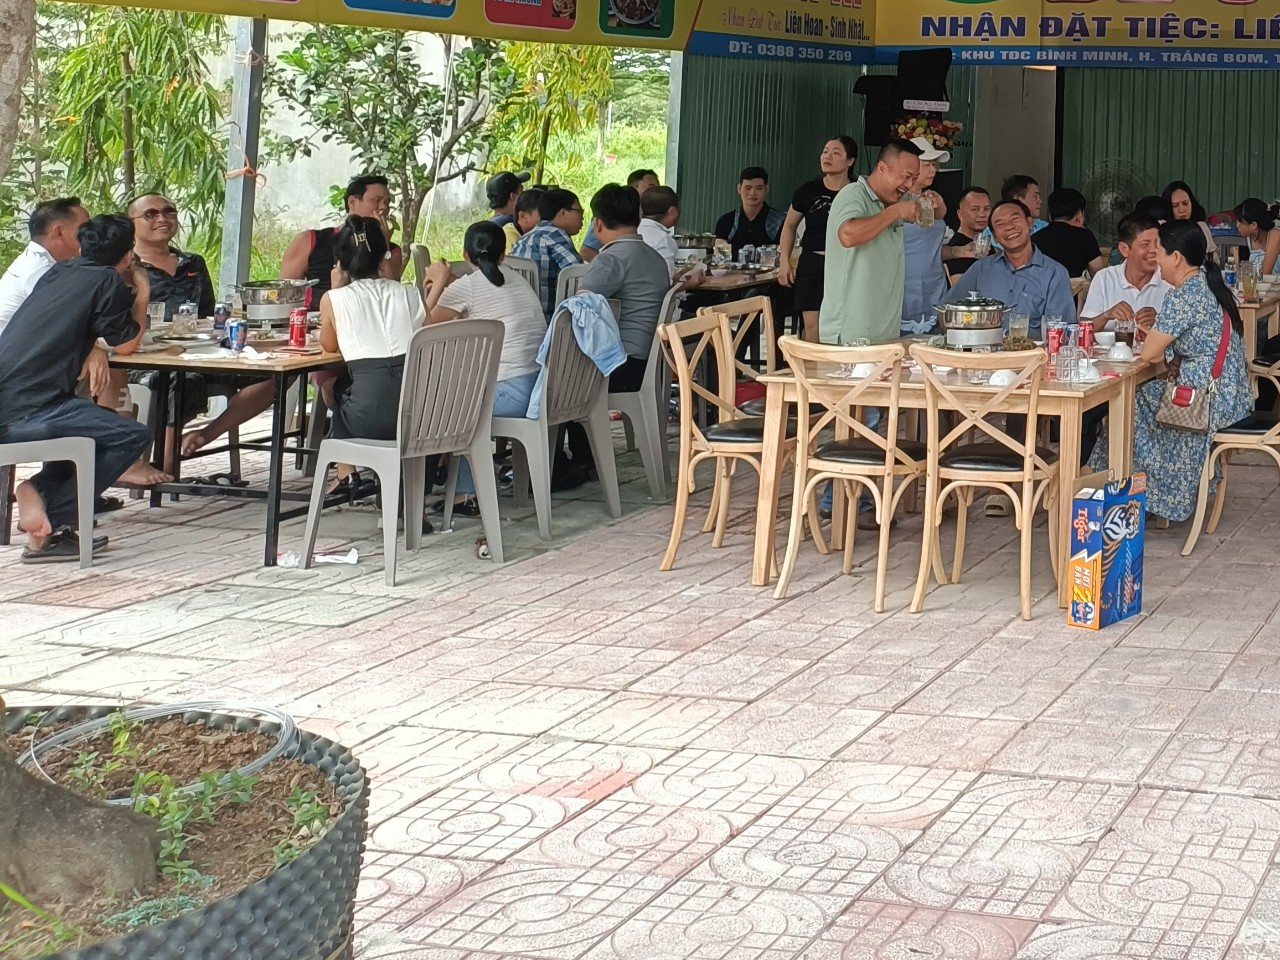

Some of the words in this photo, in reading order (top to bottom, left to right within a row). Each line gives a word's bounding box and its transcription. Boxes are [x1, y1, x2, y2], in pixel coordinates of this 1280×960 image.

[785, 10, 802, 34] Liên
[804, 13, 823, 37] Hoan
[830, 16, 847, 39] Sinh
[920, 12, 1027, 42] NHẬN
[1038, 11, 1114, 43] ĐẶT
[1123, 13, 1220, 43] TIỆC:
[729, 41, 752, 54] ĐT:
[757, 44, 794, 57] 0388
[798, 47, 824, 59] 350
[827, 50, 853, 61] 269
[962, 50, 994, 60] KHU
[1037, 48, 1077, 60] BÌNH
[1082, 51, 1133, 63] MINH,
[1139, 52, 1156, 61] H.
[1073, 507, 1089, 543] Tiger
